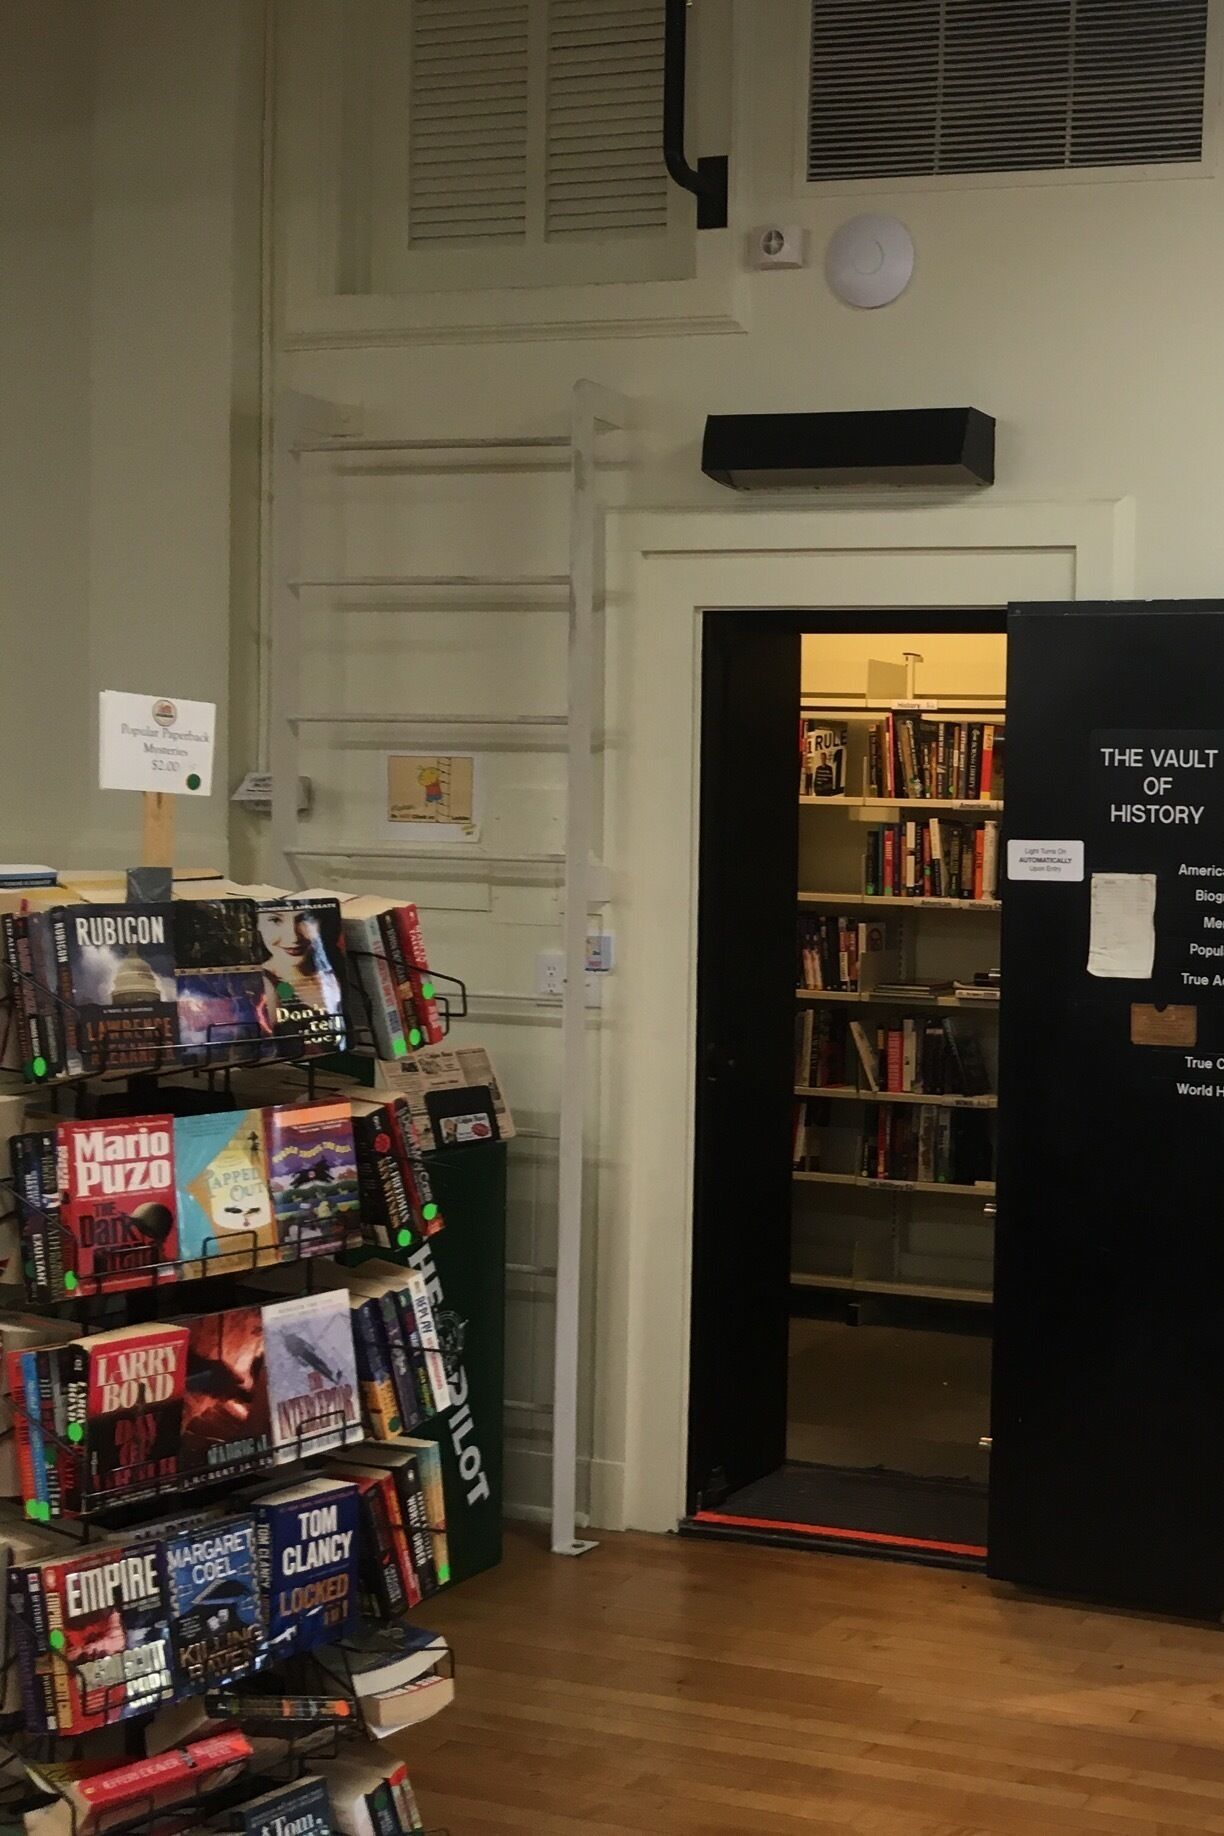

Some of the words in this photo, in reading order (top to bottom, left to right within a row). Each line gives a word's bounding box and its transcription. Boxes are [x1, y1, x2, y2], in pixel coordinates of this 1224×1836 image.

[121, 723, 159, 737] Popular
[162, 728, 209, 742] Paperback
[815, 730, 847, 751] RULE
[1100, 748, 1143, 767] THE
[1150, 749, 1219, 768] VAULT
[1143, 776, 1173, 796] OF
[1110, 804, 1204, 825] HISTORY
[54, 922, 69, 963] RUBICON
[75, 916, 165, 947] RUBICON
[1181, 973, 1210, 987] True
[1185, 1056, 1213, 1070] True
[1176, 1083, 1213, 1098] World
[72, 1128, 170, 1162] Mario
[74, 1159, 171, 1197] Puzo
[32, 1233, 48, 1286] EXULTANT
[96, 1346, 178, 1387] LARRY
[102, 1373, 175, 1414] BOND
[447, 1364, 490, 1506] PILOT
[257, 1523, 270, 1546] TOM
[297, 1505, 338, 1540] TOM
[167, 1528, 253, 1569] MARGARET
[282, 1529, 353, 1576] CLANCY
[65, 1554, 160, 1618] EMPIRE
[192, 1558, 237, 1585] COEL
[258, 1549, 272, 1589] CLANCY
[280, 1573, 349, 1617] LOCKED
[179, 1623, 265, 1664] KILLING
